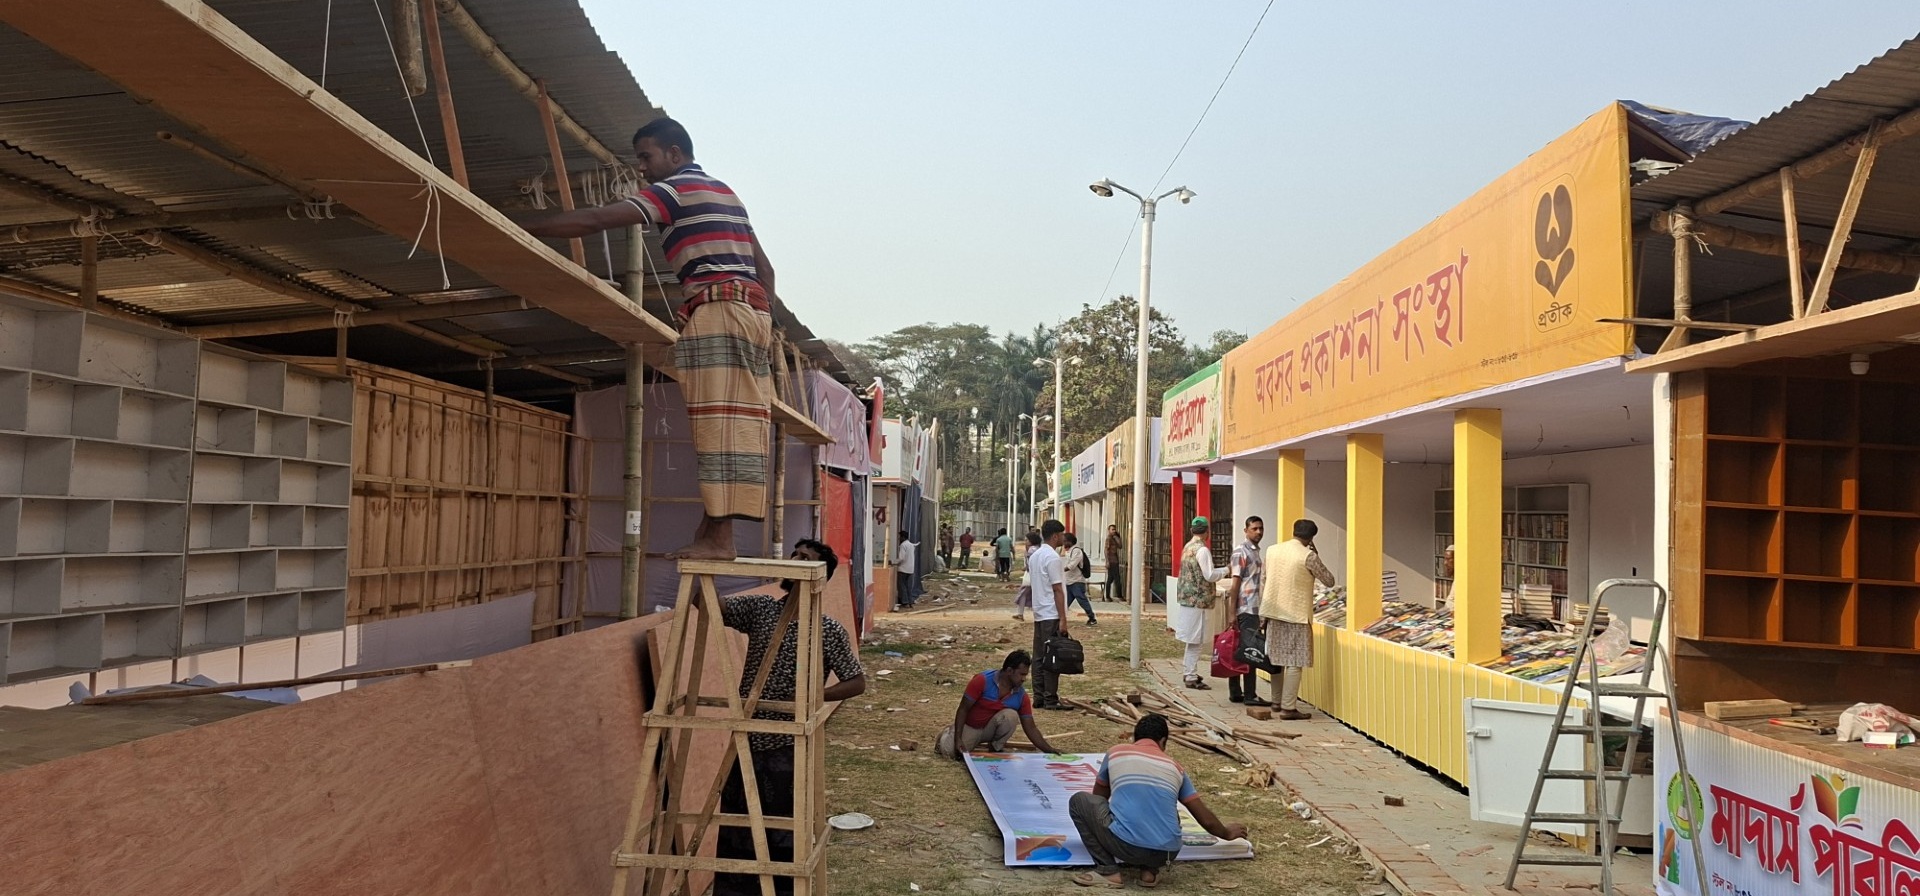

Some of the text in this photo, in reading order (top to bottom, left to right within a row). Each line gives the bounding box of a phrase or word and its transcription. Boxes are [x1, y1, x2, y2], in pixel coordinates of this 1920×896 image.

[1255, 246, 1469, 415] অবসর প্রকাশনা সংস্থা
[1537, 301, 1573, 328] প্রতীক
[1709, 782, 1806, 885] মাদার্স
[1808, 818, 1920, 896] পাবি
